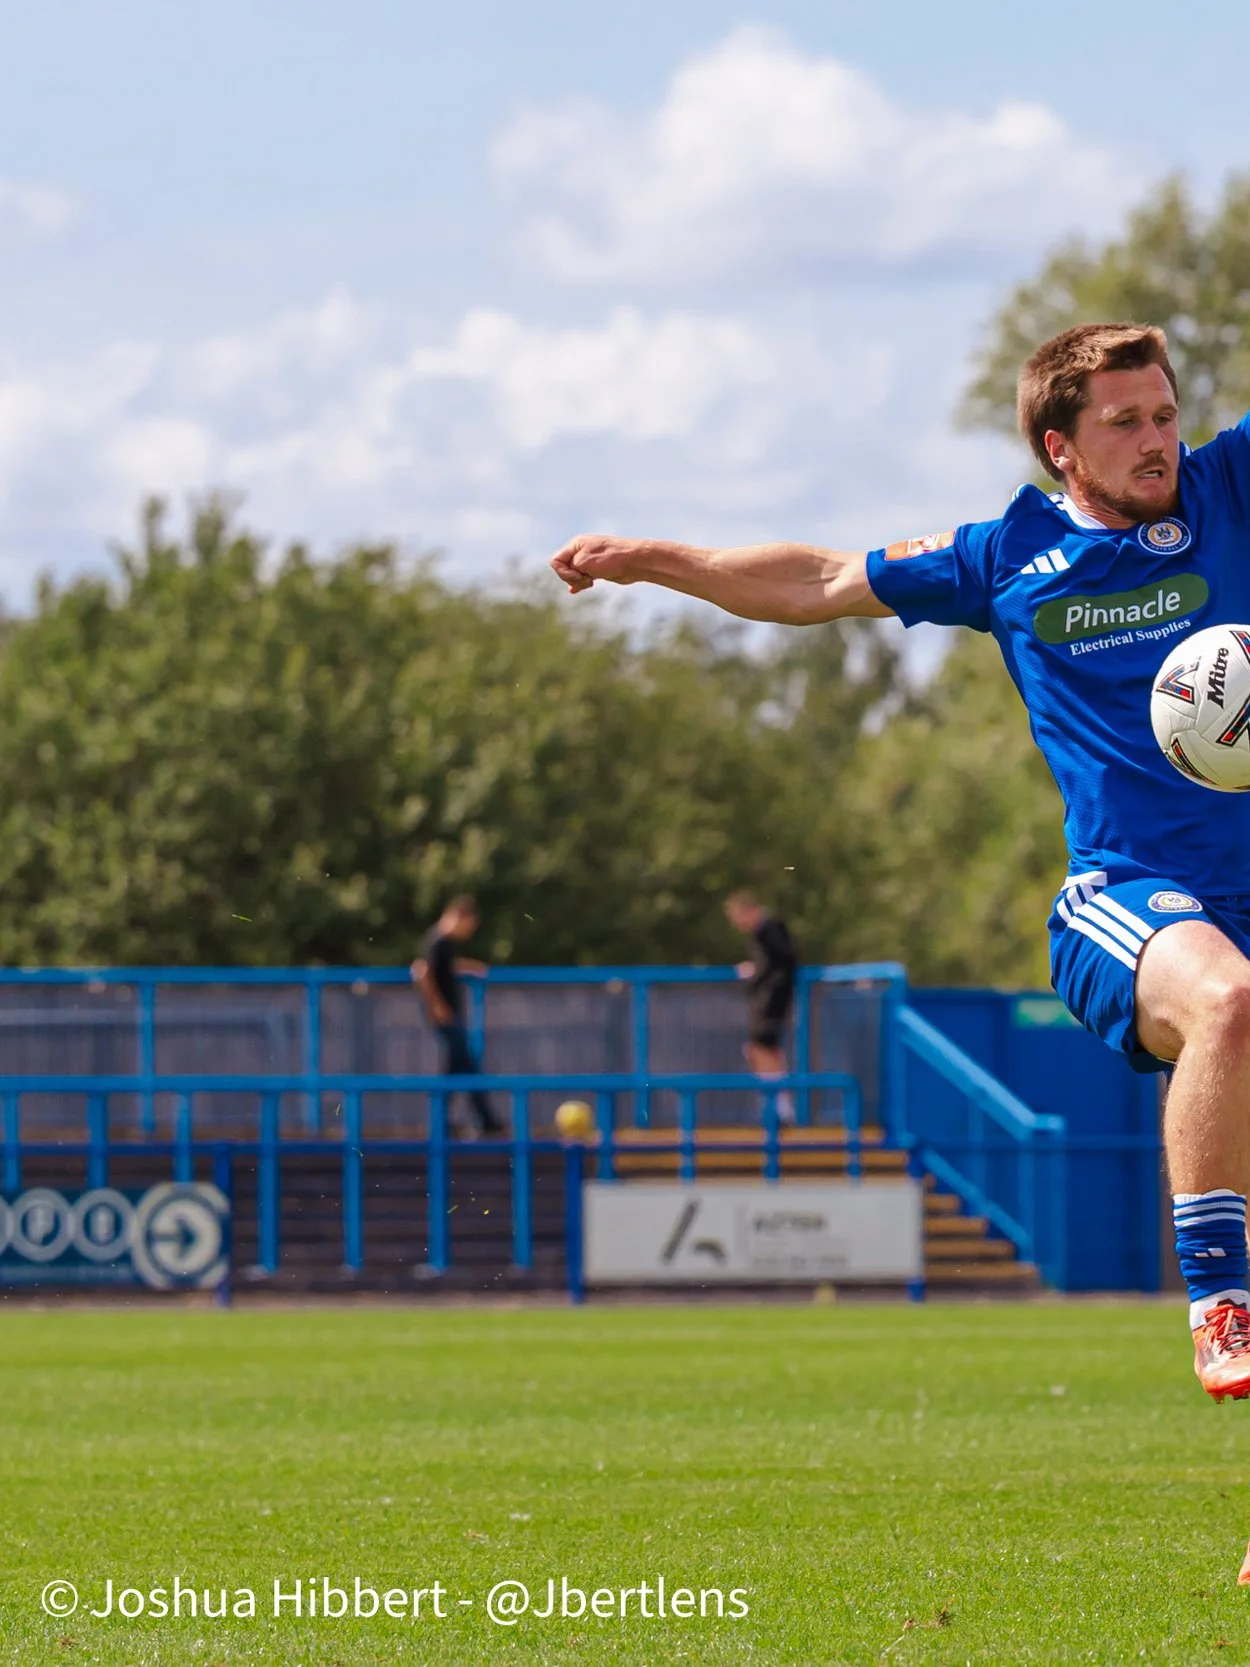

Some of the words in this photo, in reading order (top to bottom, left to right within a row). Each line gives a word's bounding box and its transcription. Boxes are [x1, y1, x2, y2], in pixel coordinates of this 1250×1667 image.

[1065, 589, 1181, 633] Pinnacle
[1070, 631, 1134, 656] Electrical
[1135, 618, 1192, 641] Supplies
[1207, 647, 1229, 710] Mitre
